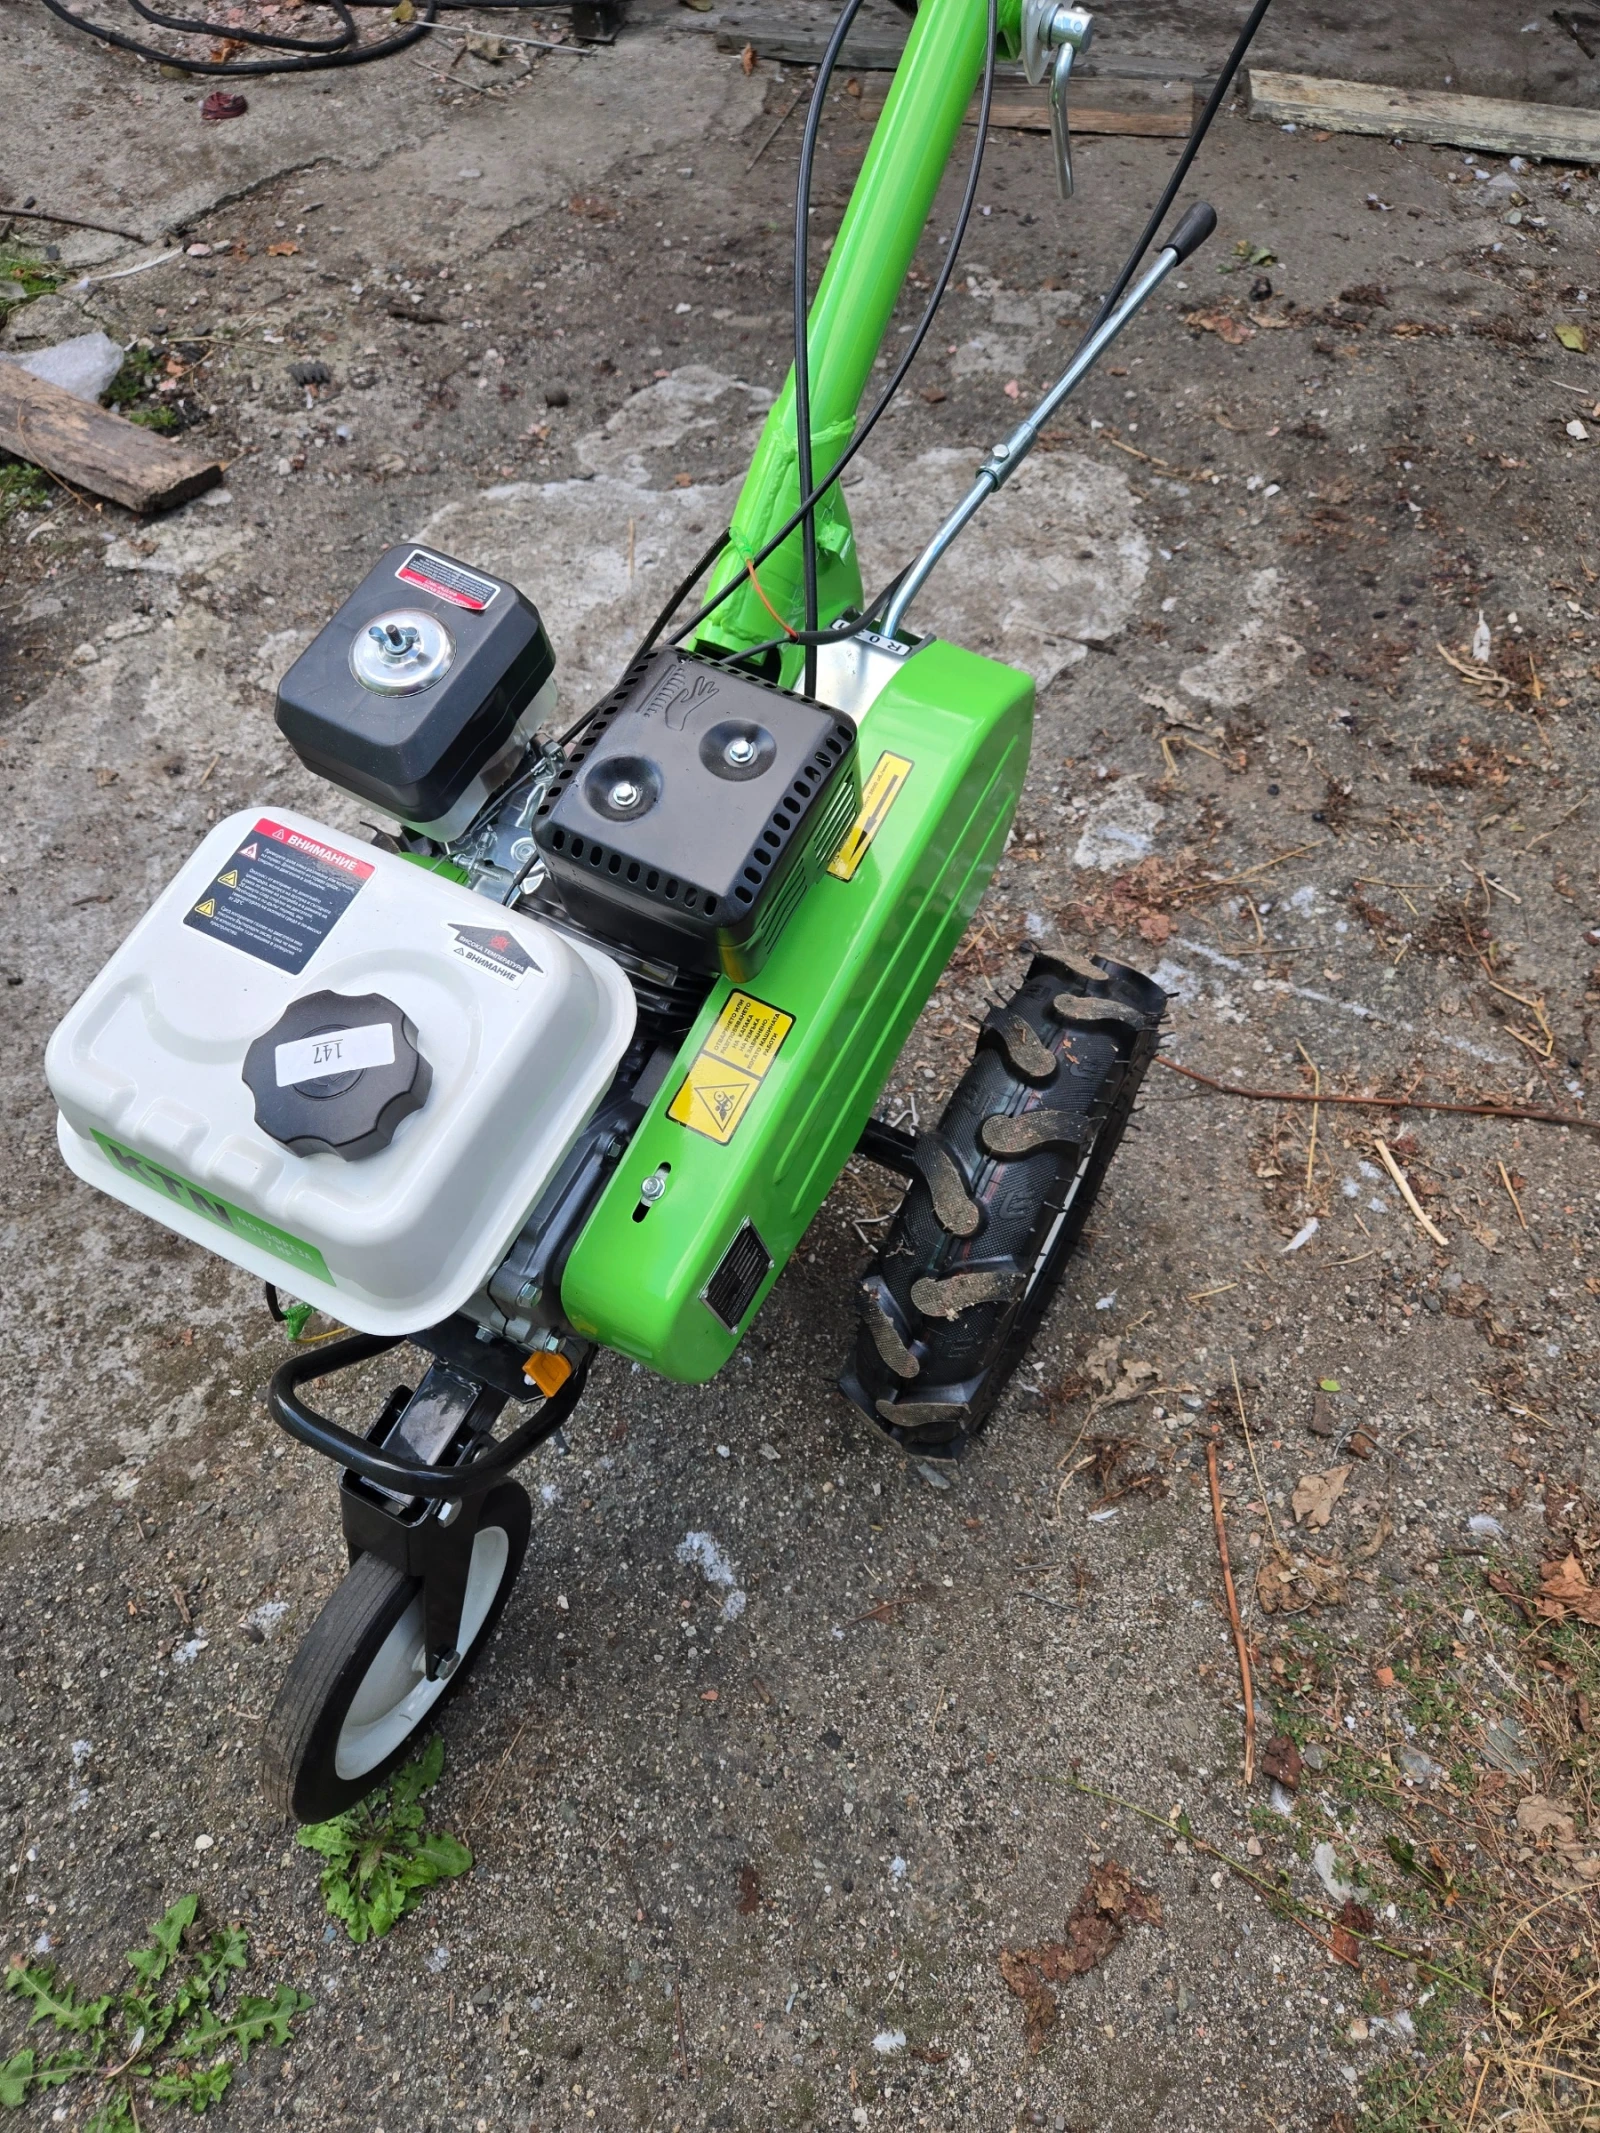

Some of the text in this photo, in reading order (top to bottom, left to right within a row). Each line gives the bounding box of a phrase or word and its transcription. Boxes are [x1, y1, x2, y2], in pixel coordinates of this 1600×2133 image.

[887, 641, 901, 652] R
[287, 834, 357, 871] ВНИМАНИЕ
[458, 935, 524, 971] ВИСОКА ТЕМПЕРАТУРА
[465, 951, 516, 981] ВНИМАНИЕ
[713, 999, 744, 1050] ОТВАРЯНЕТО ИЛИ
[719, 1002, 751, 1054] РАЗГЛОБЯВАНЕТО
[732, 1014, 753, 1048] НА КАПАКА
[739, 1017, 759, 1051] НА РЕМЪКА
[746, 1012, 780, 1069] КОГАТО МАШИНАТА
[311, 1041, 342, 1064] 147
[762, 1032, 777, 1056] РАБОТИ
[106, 1143, 235, 1228] KTN
[235, 1215, 313, 1262] МОТОФРЕЗА
